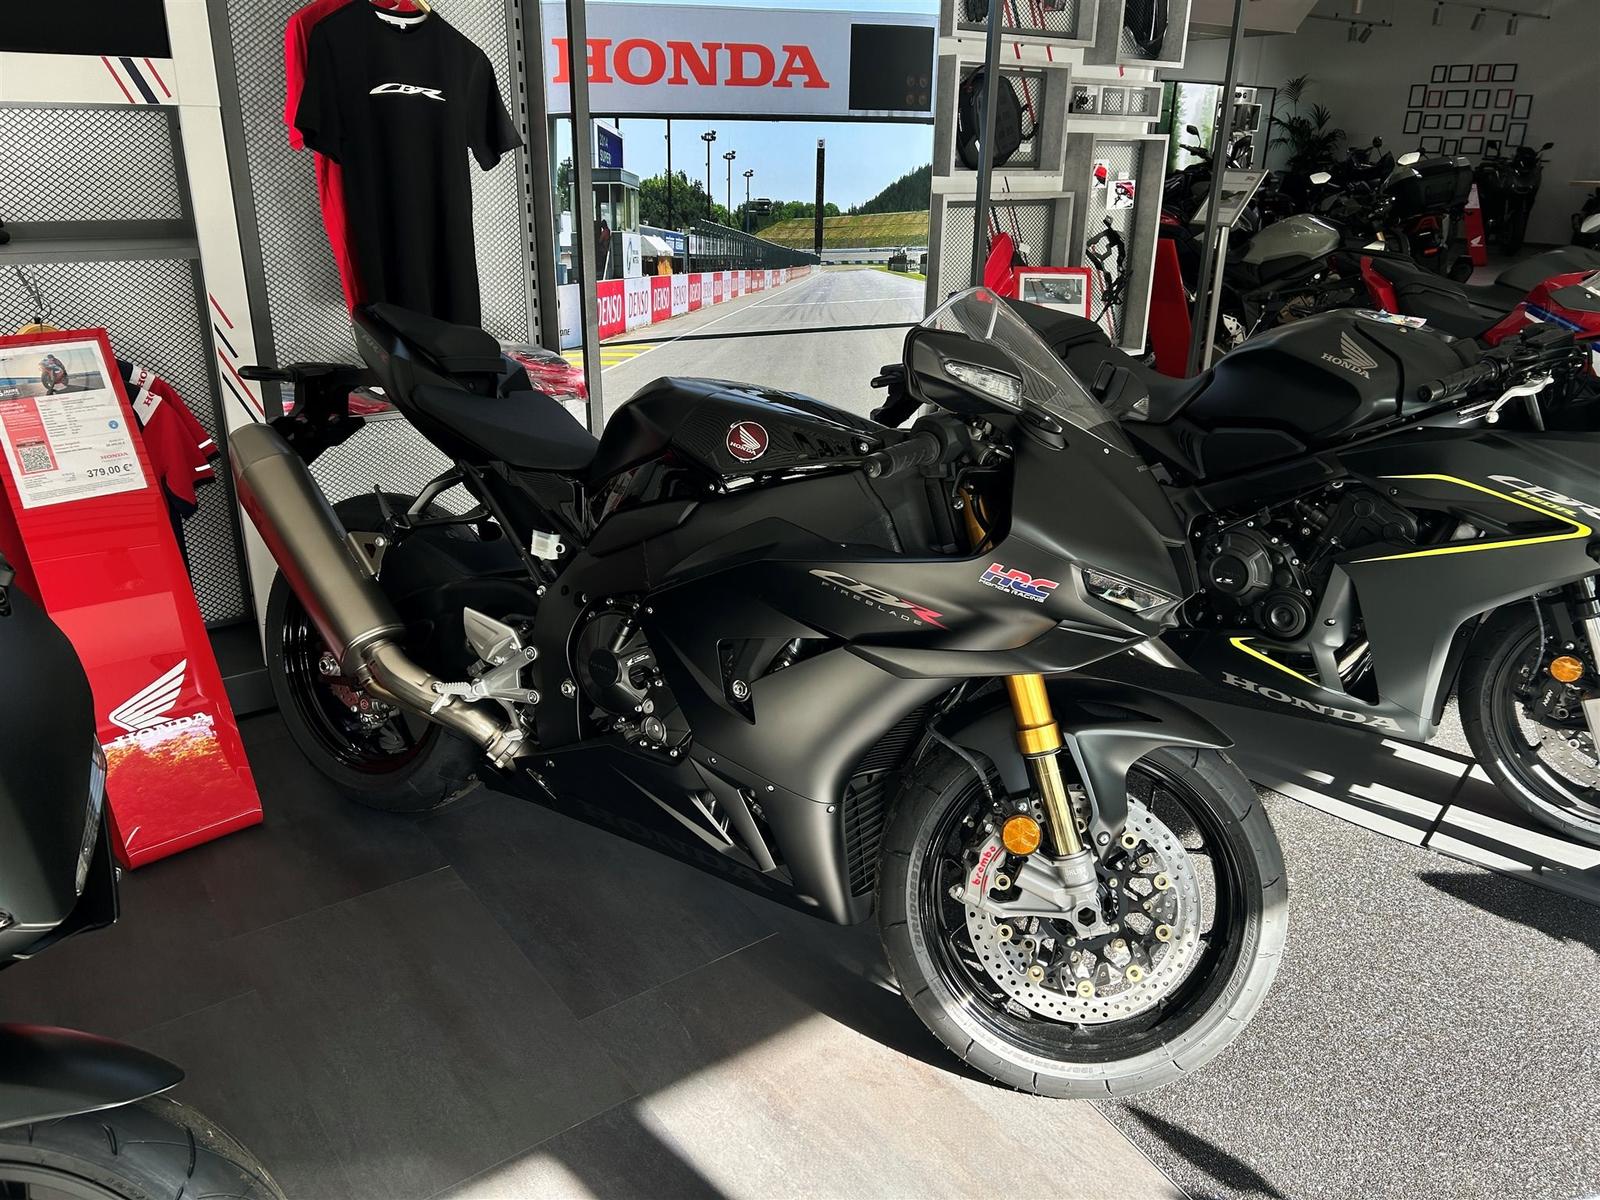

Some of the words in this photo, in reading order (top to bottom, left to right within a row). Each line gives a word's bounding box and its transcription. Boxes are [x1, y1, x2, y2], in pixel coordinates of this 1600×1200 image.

[552, 38, 829, 89] HONDA
[369, 83, 446, 101] CBR
[629, 290, 648, 318] DENSO
[653, 286, 670, 311] DENSO
[673, 285, 687, 306] DENSO
[1321, 353, 1370, 379] HONDA
[100, 452, 129, 460] HONDA
[730, 441, 757, 456] HONDA
[86, 464, 121, 478] 379,00
[980, 563, 1060, 600] HRC
[809, 569, 948, 629] CBR
[821, 581, 923, 626] FIREBLADE
[1010, 590, 1044, 603] RACING
[1222, 671, 1405, 732] HONDA
[113, 711, 214, 747] HONDA
[971, 846, 996, 886] brembo
